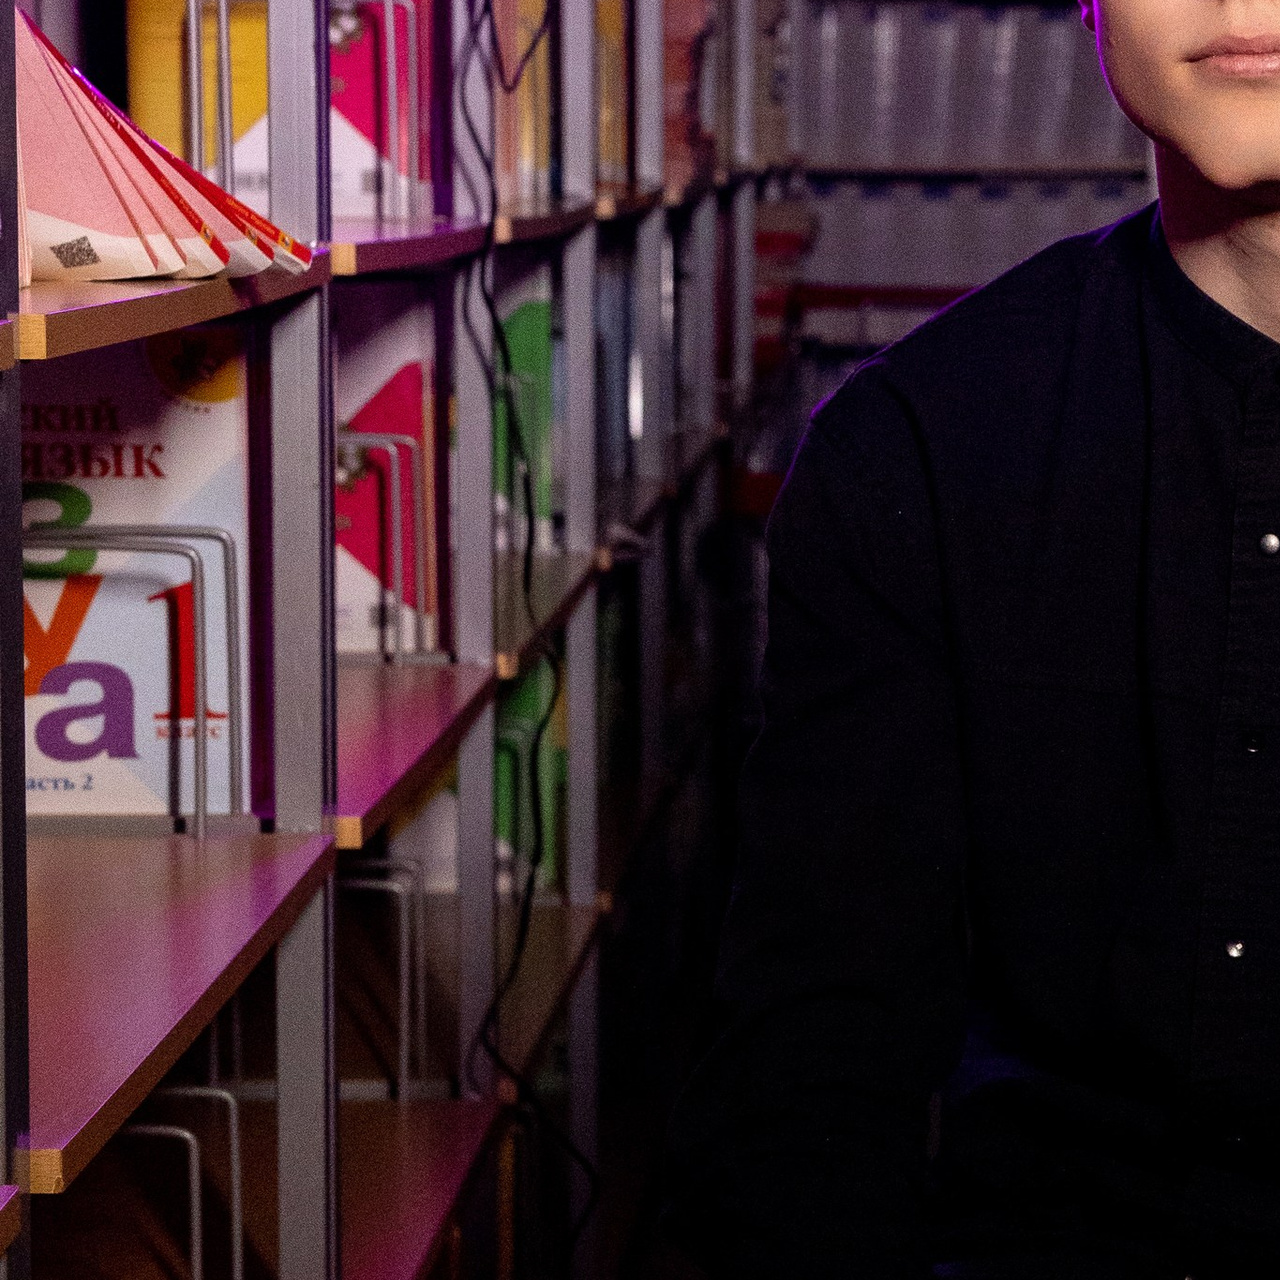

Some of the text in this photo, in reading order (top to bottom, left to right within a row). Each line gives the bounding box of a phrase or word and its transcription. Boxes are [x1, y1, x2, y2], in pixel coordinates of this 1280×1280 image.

[149, 580, 229, 720] 1
[26, 773, 93, 791] асть 2
